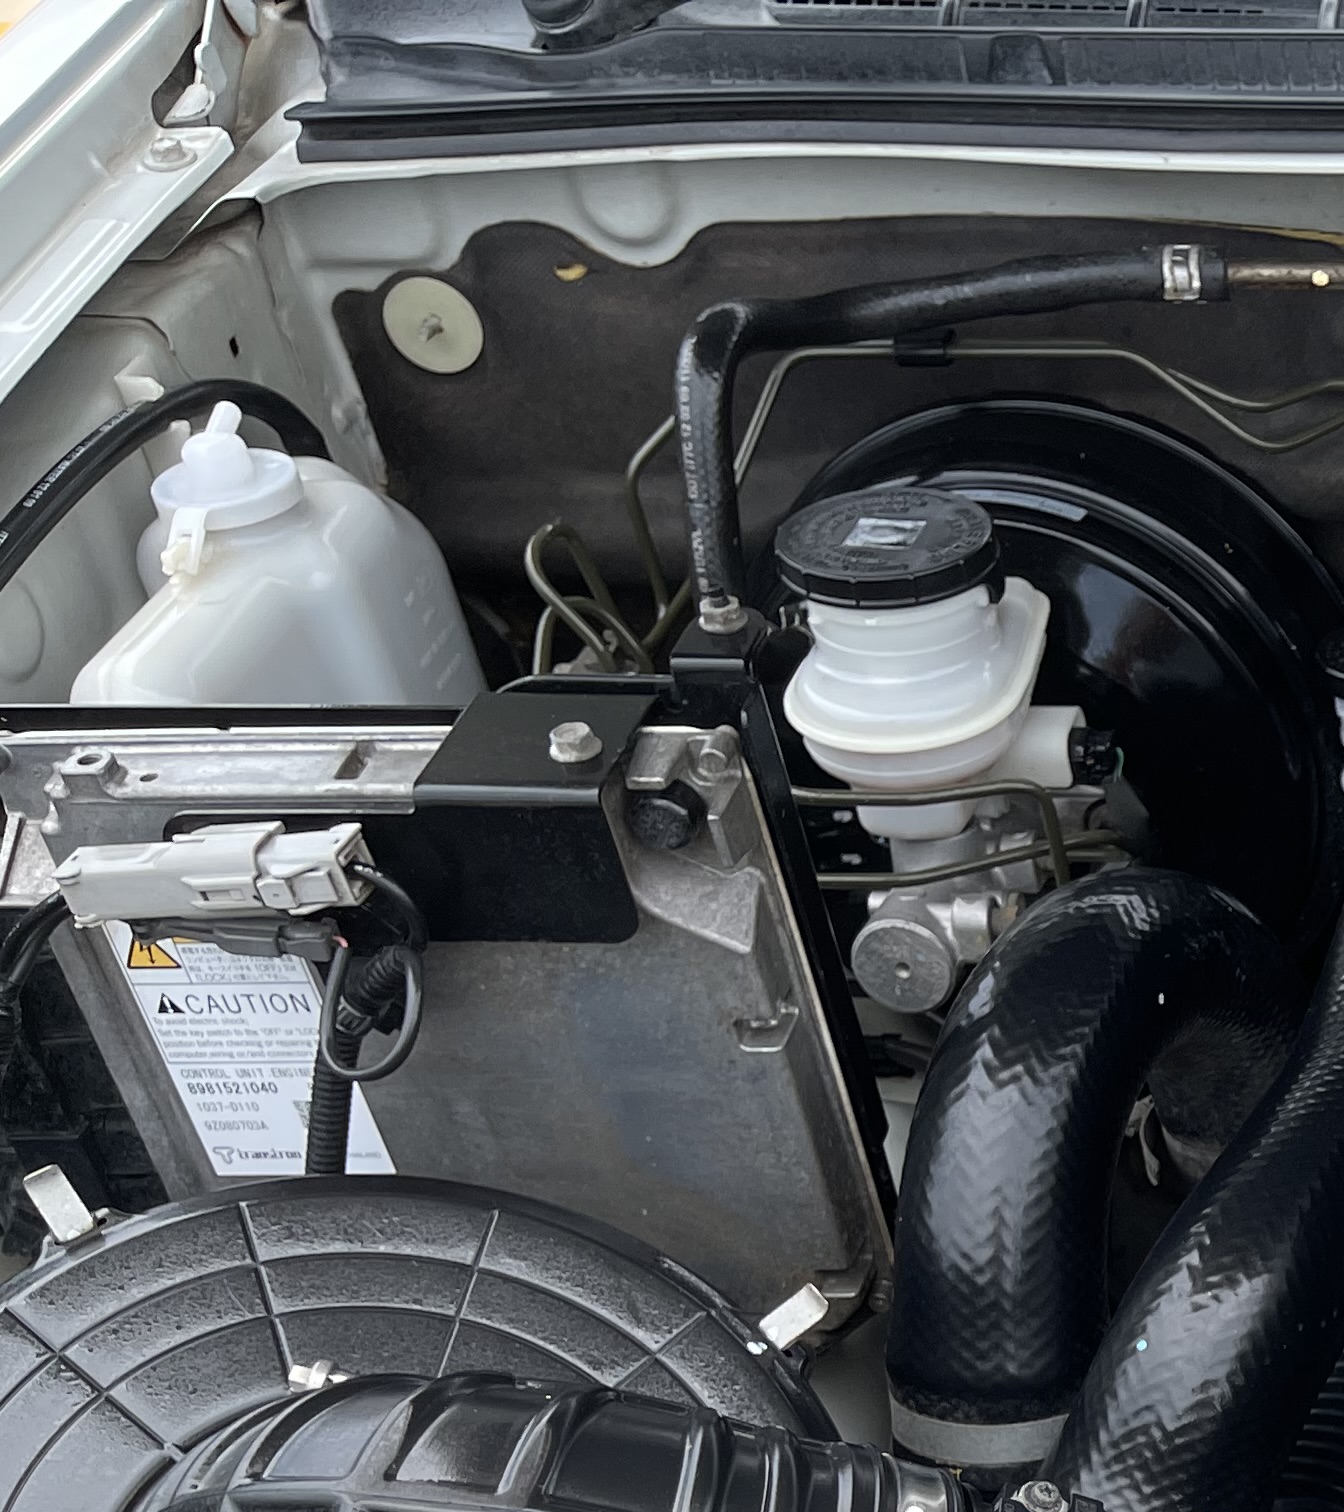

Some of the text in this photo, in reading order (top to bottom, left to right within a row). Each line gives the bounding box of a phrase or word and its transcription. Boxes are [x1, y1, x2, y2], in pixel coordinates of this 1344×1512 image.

[184, 992, 312, 1015] CAUTION
[180, 1068, 231, 1080] CONTROL
[187, 1082, 279, 1095] 8981521040
